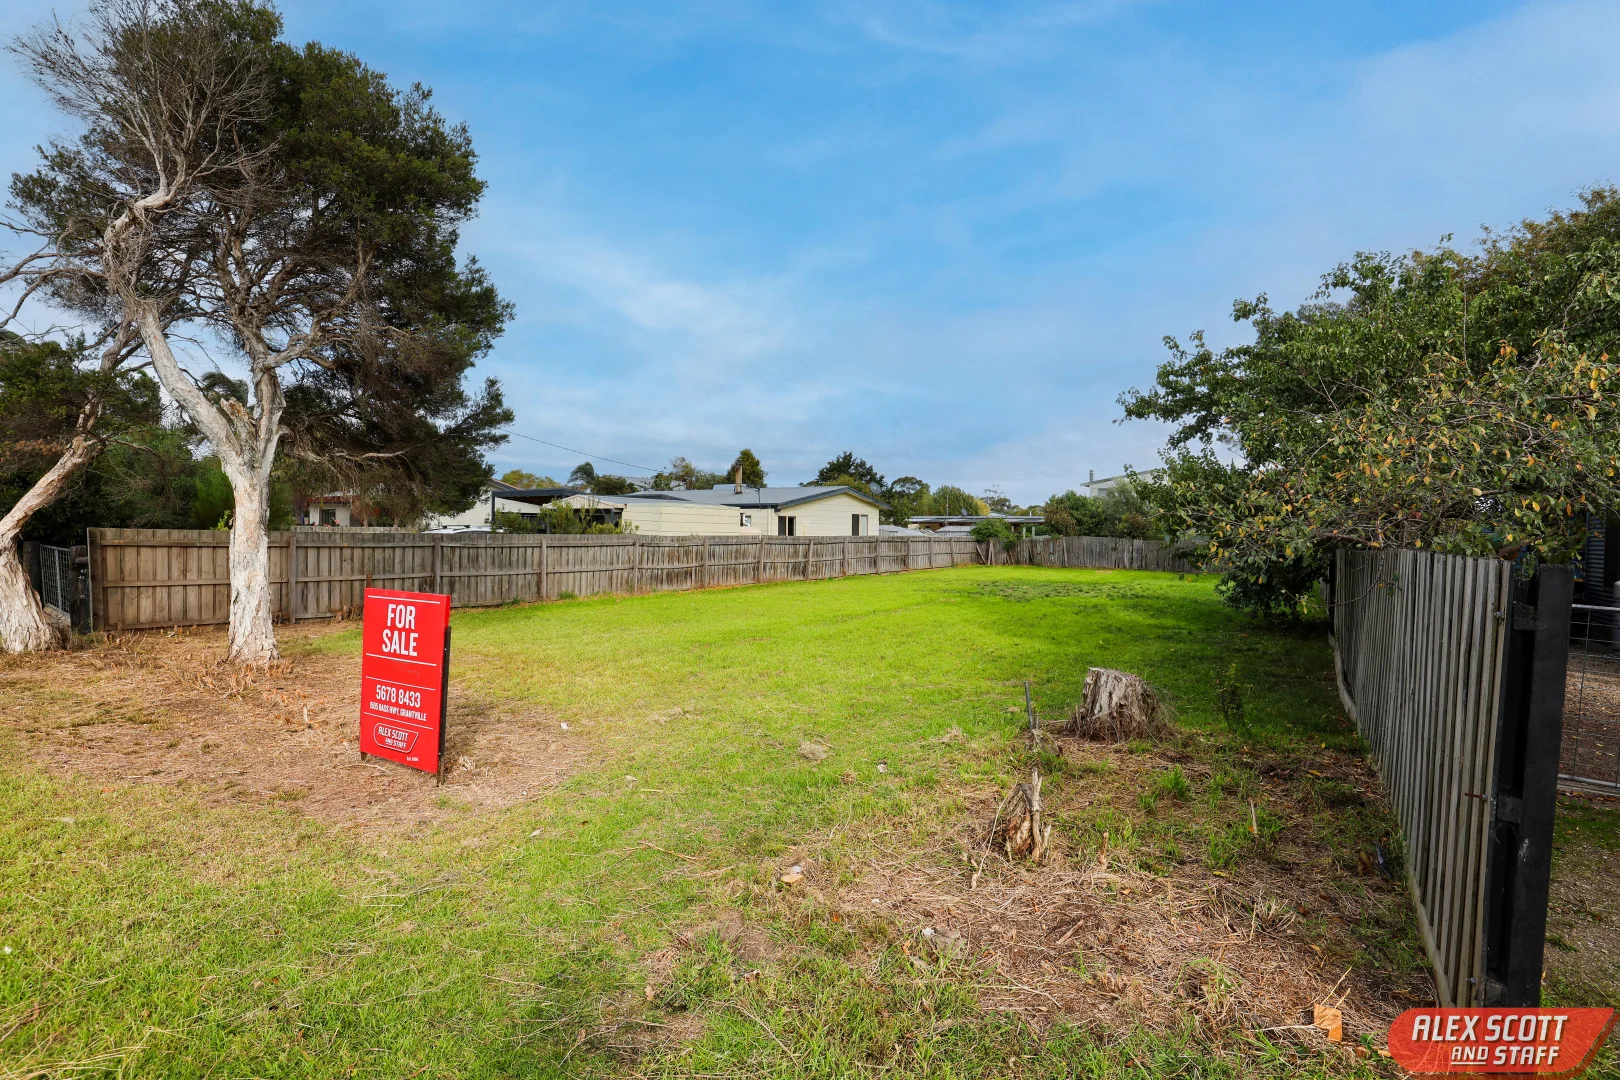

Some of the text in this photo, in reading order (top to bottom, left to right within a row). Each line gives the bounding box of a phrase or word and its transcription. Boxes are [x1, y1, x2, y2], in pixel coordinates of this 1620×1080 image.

[387, 603, 416, 629] FOR
[382, 629, 419, 656] SALE
[376, 685, 421, 708] 5678 8433
[400, 708, 427, 721] GRANTVILLE
[378, 726, 409, 741] ALEX SCOTT
[393, 739, 407, 749] STAFF
